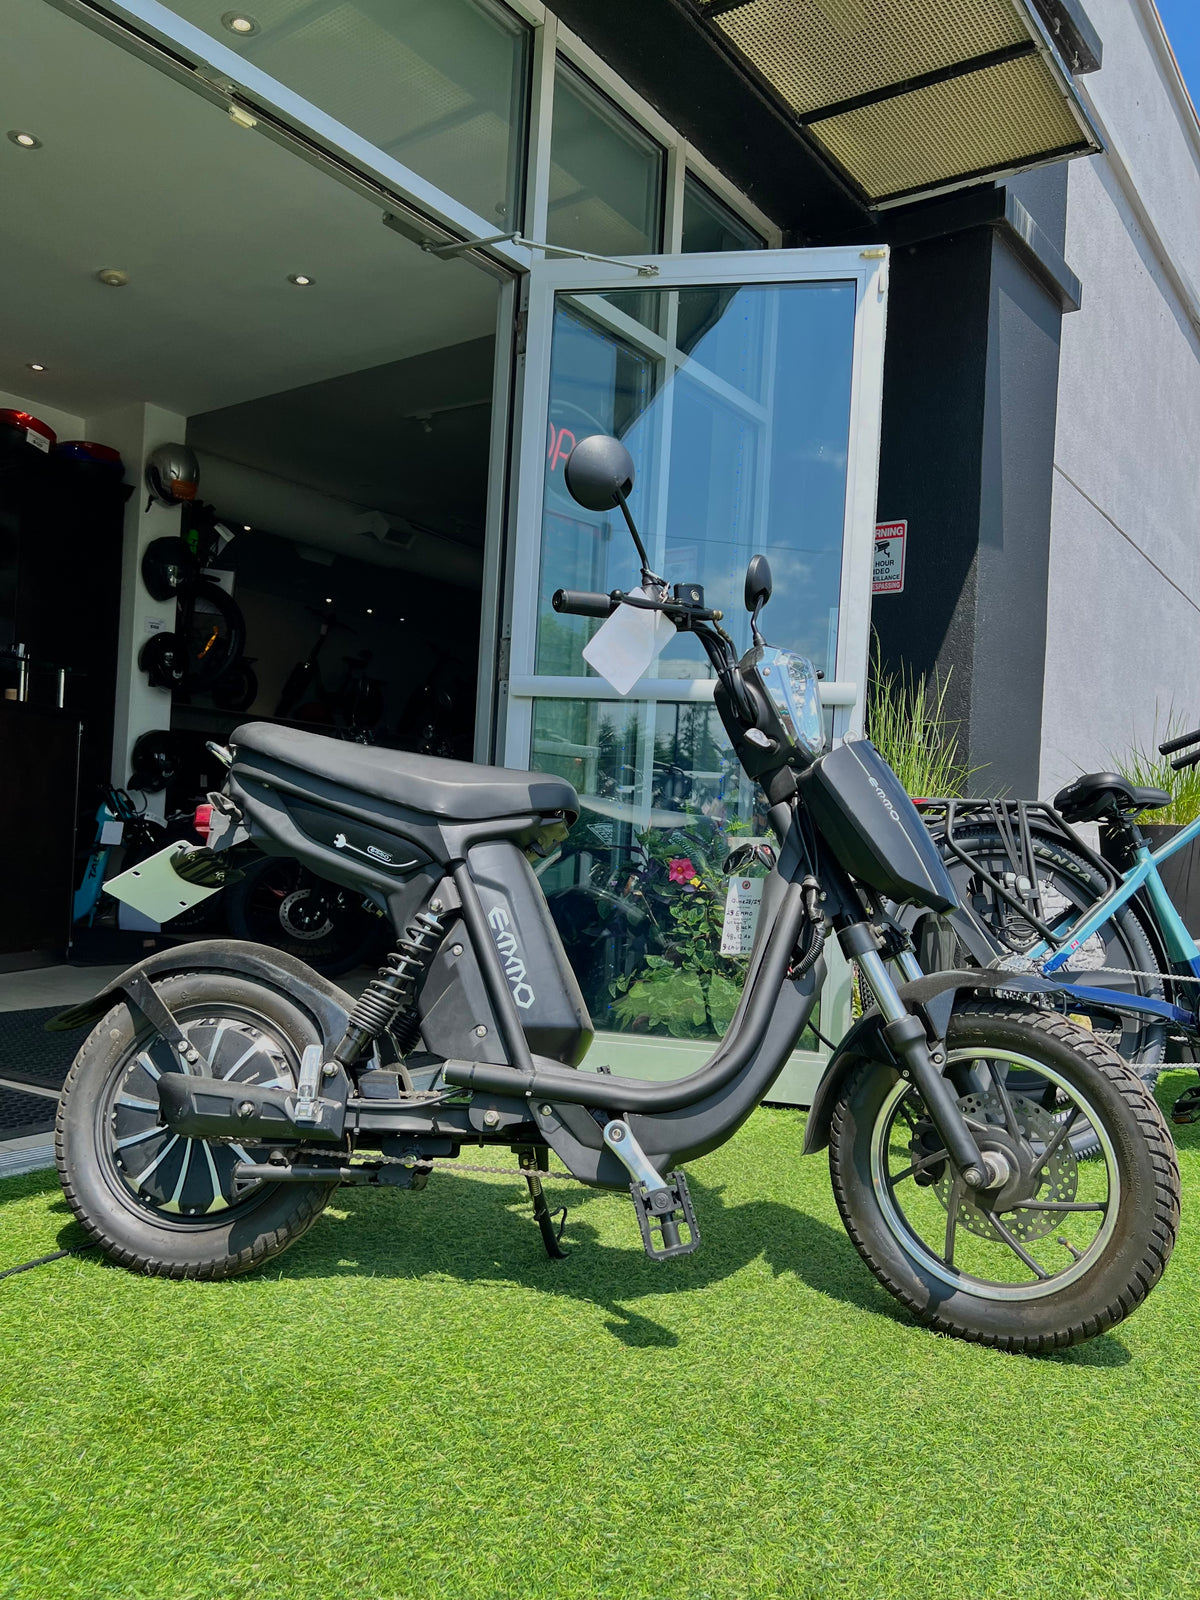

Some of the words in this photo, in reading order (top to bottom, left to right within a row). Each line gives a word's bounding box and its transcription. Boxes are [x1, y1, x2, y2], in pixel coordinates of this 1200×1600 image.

[875, 560, 895, 568] HOUR
[869, 776, 900, 821] EMMO
[488, 906, 535, 1009] EMMO
